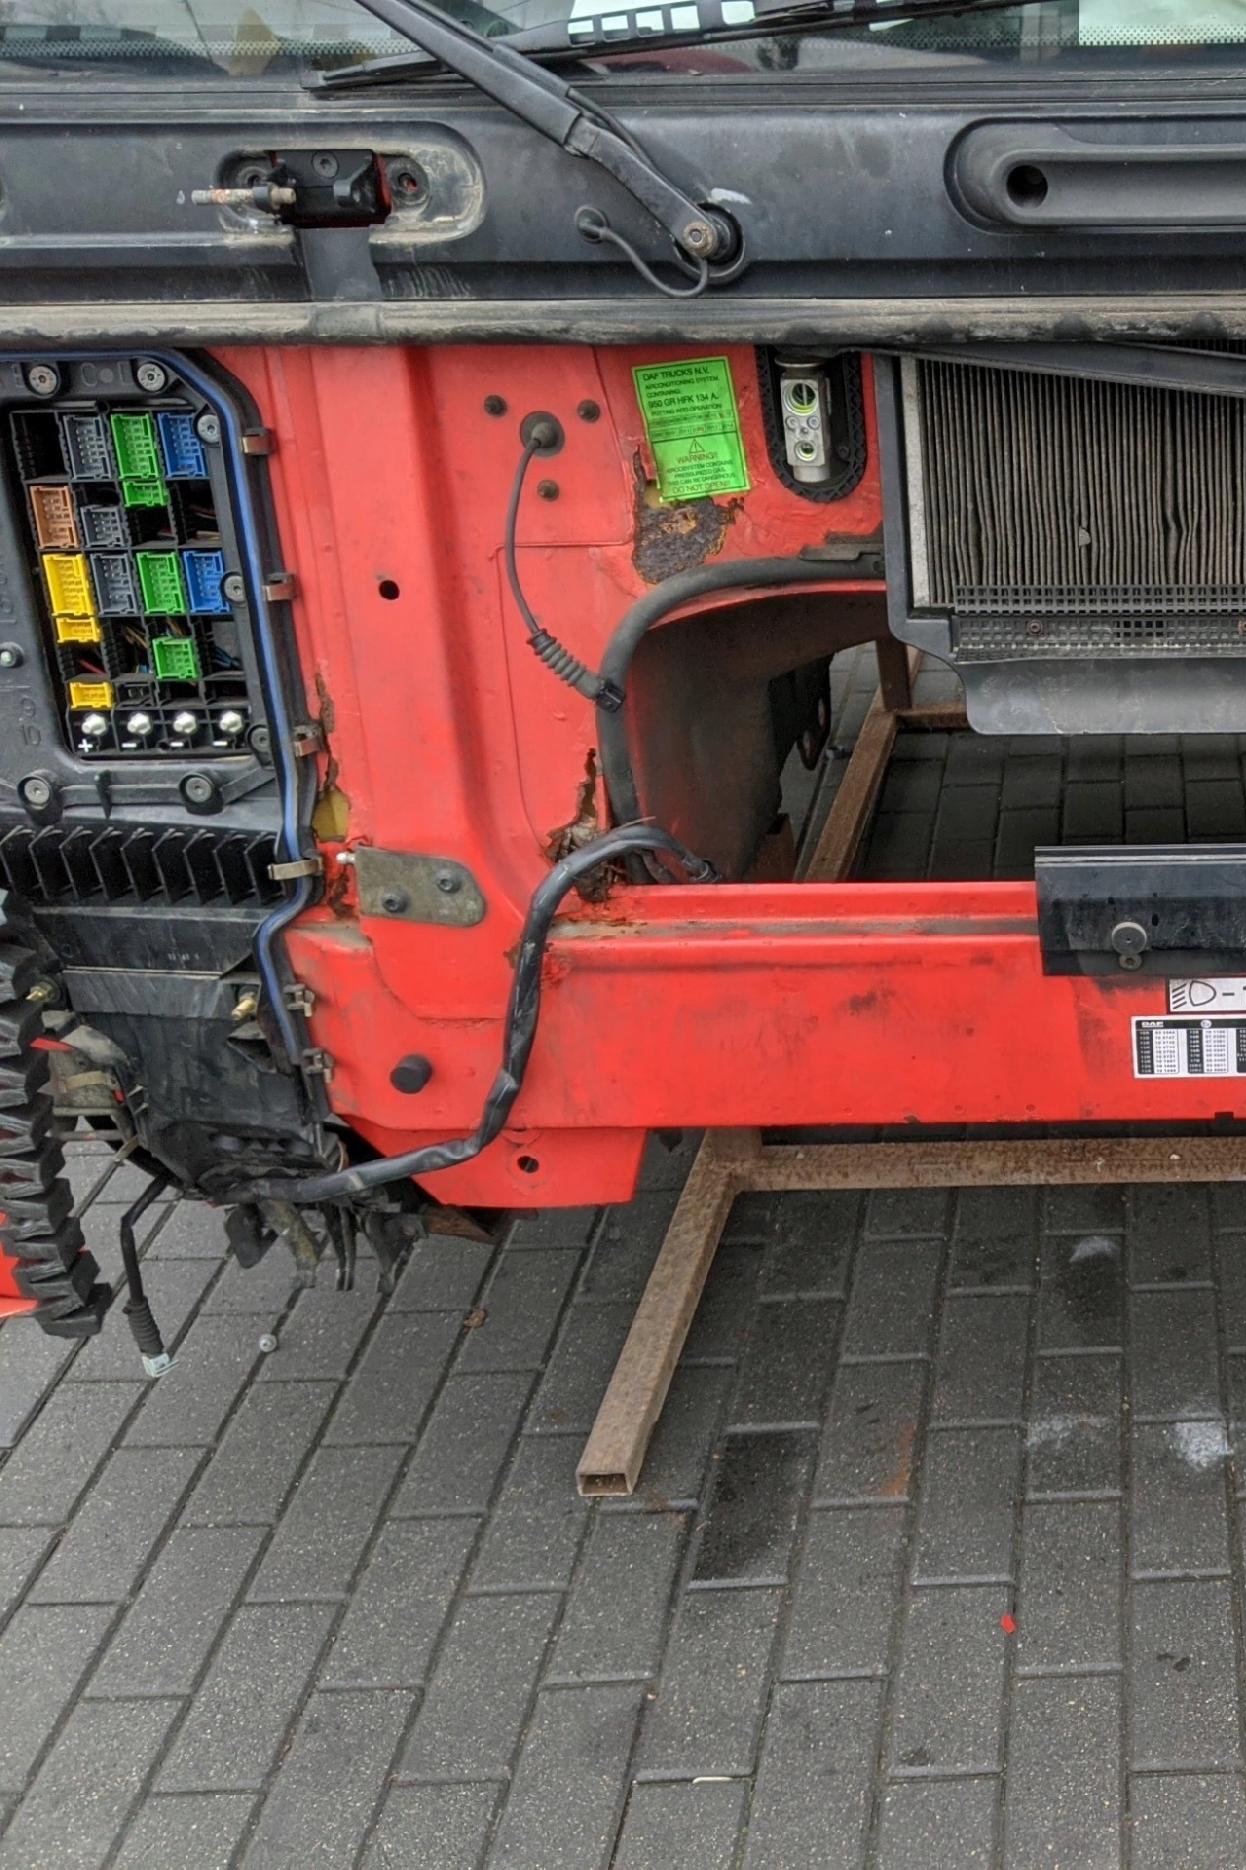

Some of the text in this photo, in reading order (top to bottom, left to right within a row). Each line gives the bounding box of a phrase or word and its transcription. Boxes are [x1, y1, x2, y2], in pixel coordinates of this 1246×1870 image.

[642, 373, 659, 381] DAF
[661, 369, 693, 378] TRUCKS
[677, 395, 694, 405] HFK
[695, 393, 709, 402] 134
